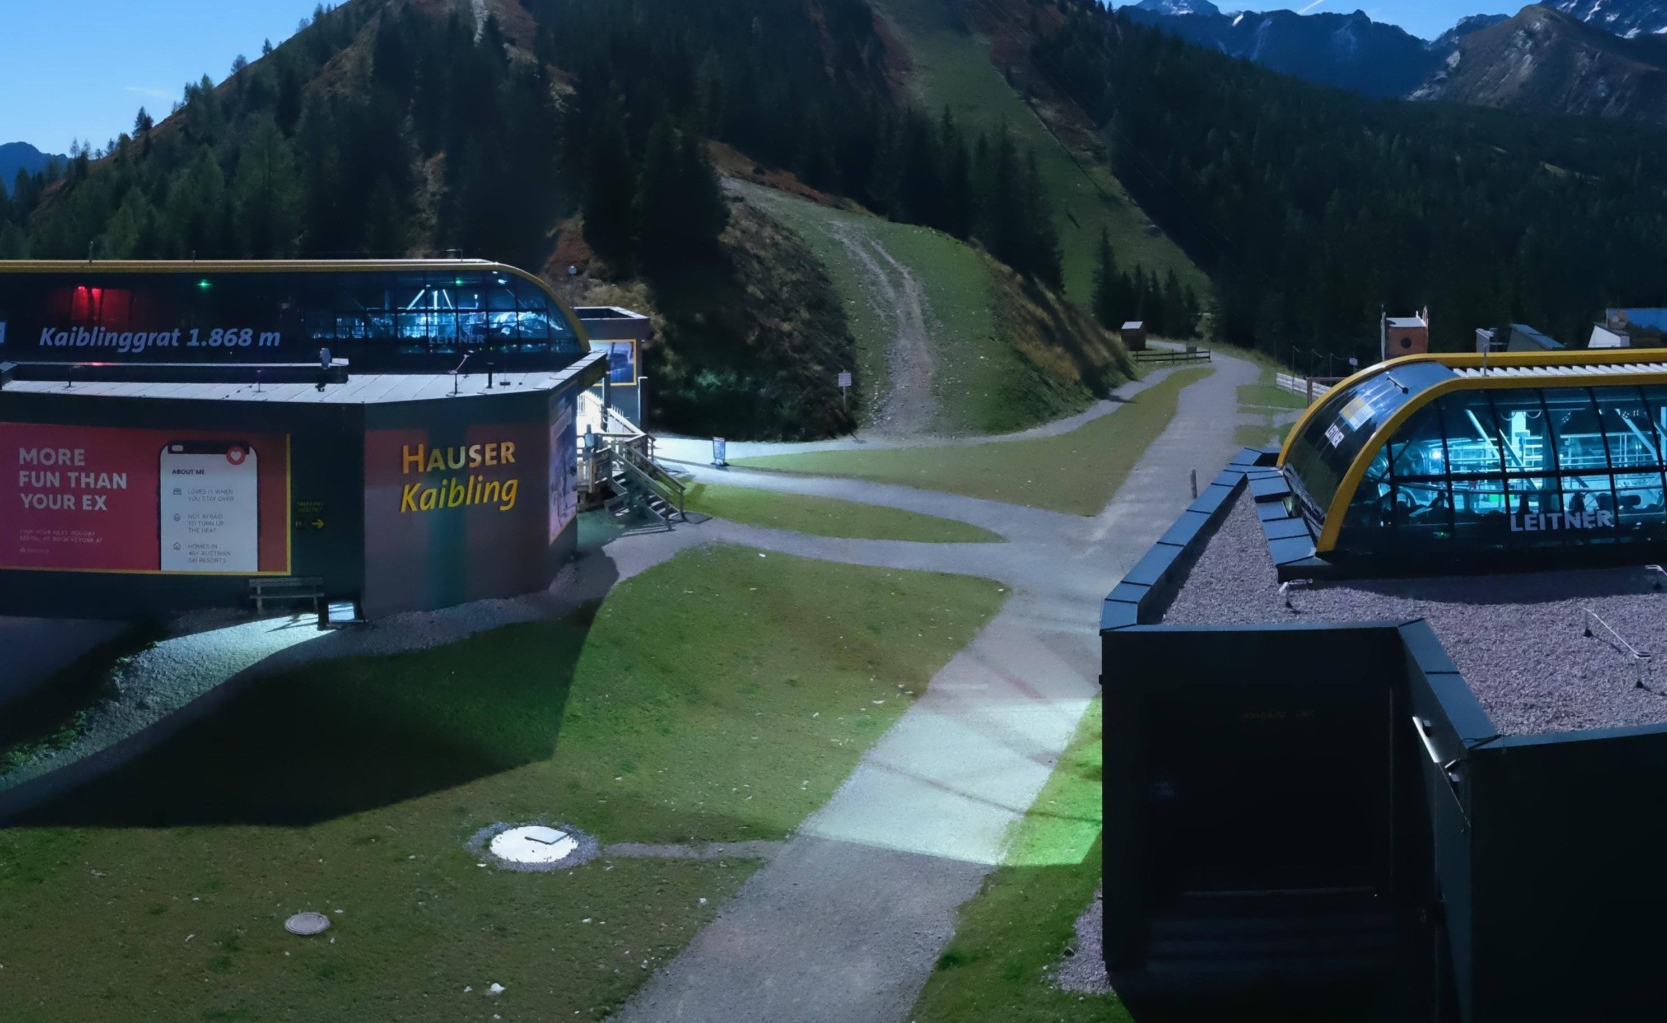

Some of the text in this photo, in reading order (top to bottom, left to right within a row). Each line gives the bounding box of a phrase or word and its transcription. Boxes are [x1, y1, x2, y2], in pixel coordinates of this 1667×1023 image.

[39, 327, 281, 353] Kaiblinggrat 1.868 m
[429, 334, 485, 344] LEITNER
[19, 447, 85, 466] MORE
[402, 441, 516, 474] HAUSER
[19, 470, 128, 490] FUN THAN
[20, 493, 108, 511] YOUR EX
[400, 475, 519, 513] Kaibling
[1510, 510, 1613, 532] LEITNER
